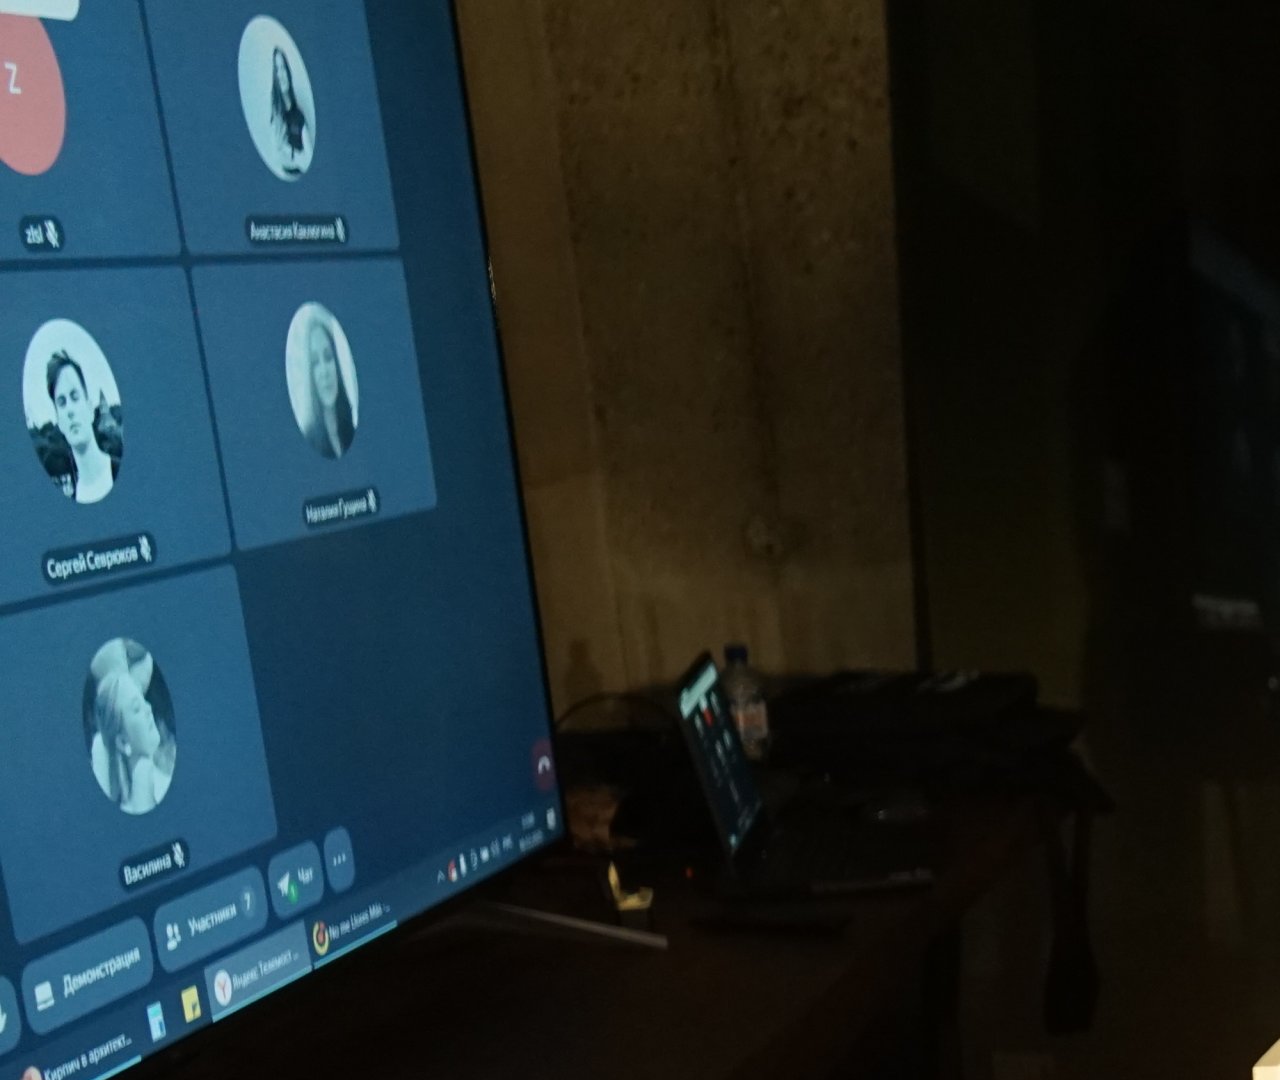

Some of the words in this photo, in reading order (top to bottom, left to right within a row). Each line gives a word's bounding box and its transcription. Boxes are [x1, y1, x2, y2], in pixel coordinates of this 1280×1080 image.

[47, 552, 87, 579] Сергей
[86, 545, 138, 570] Севрюков
[123, 853, 172, 886] Василина
[297, 866, 313, 885] Чат
[187, 903, 238, 937] Участники
[62, 947, 141, 998] Демонстрация
[232, 966, 259, 991] Яндекс
[80, 1053, 89, 1069] в
